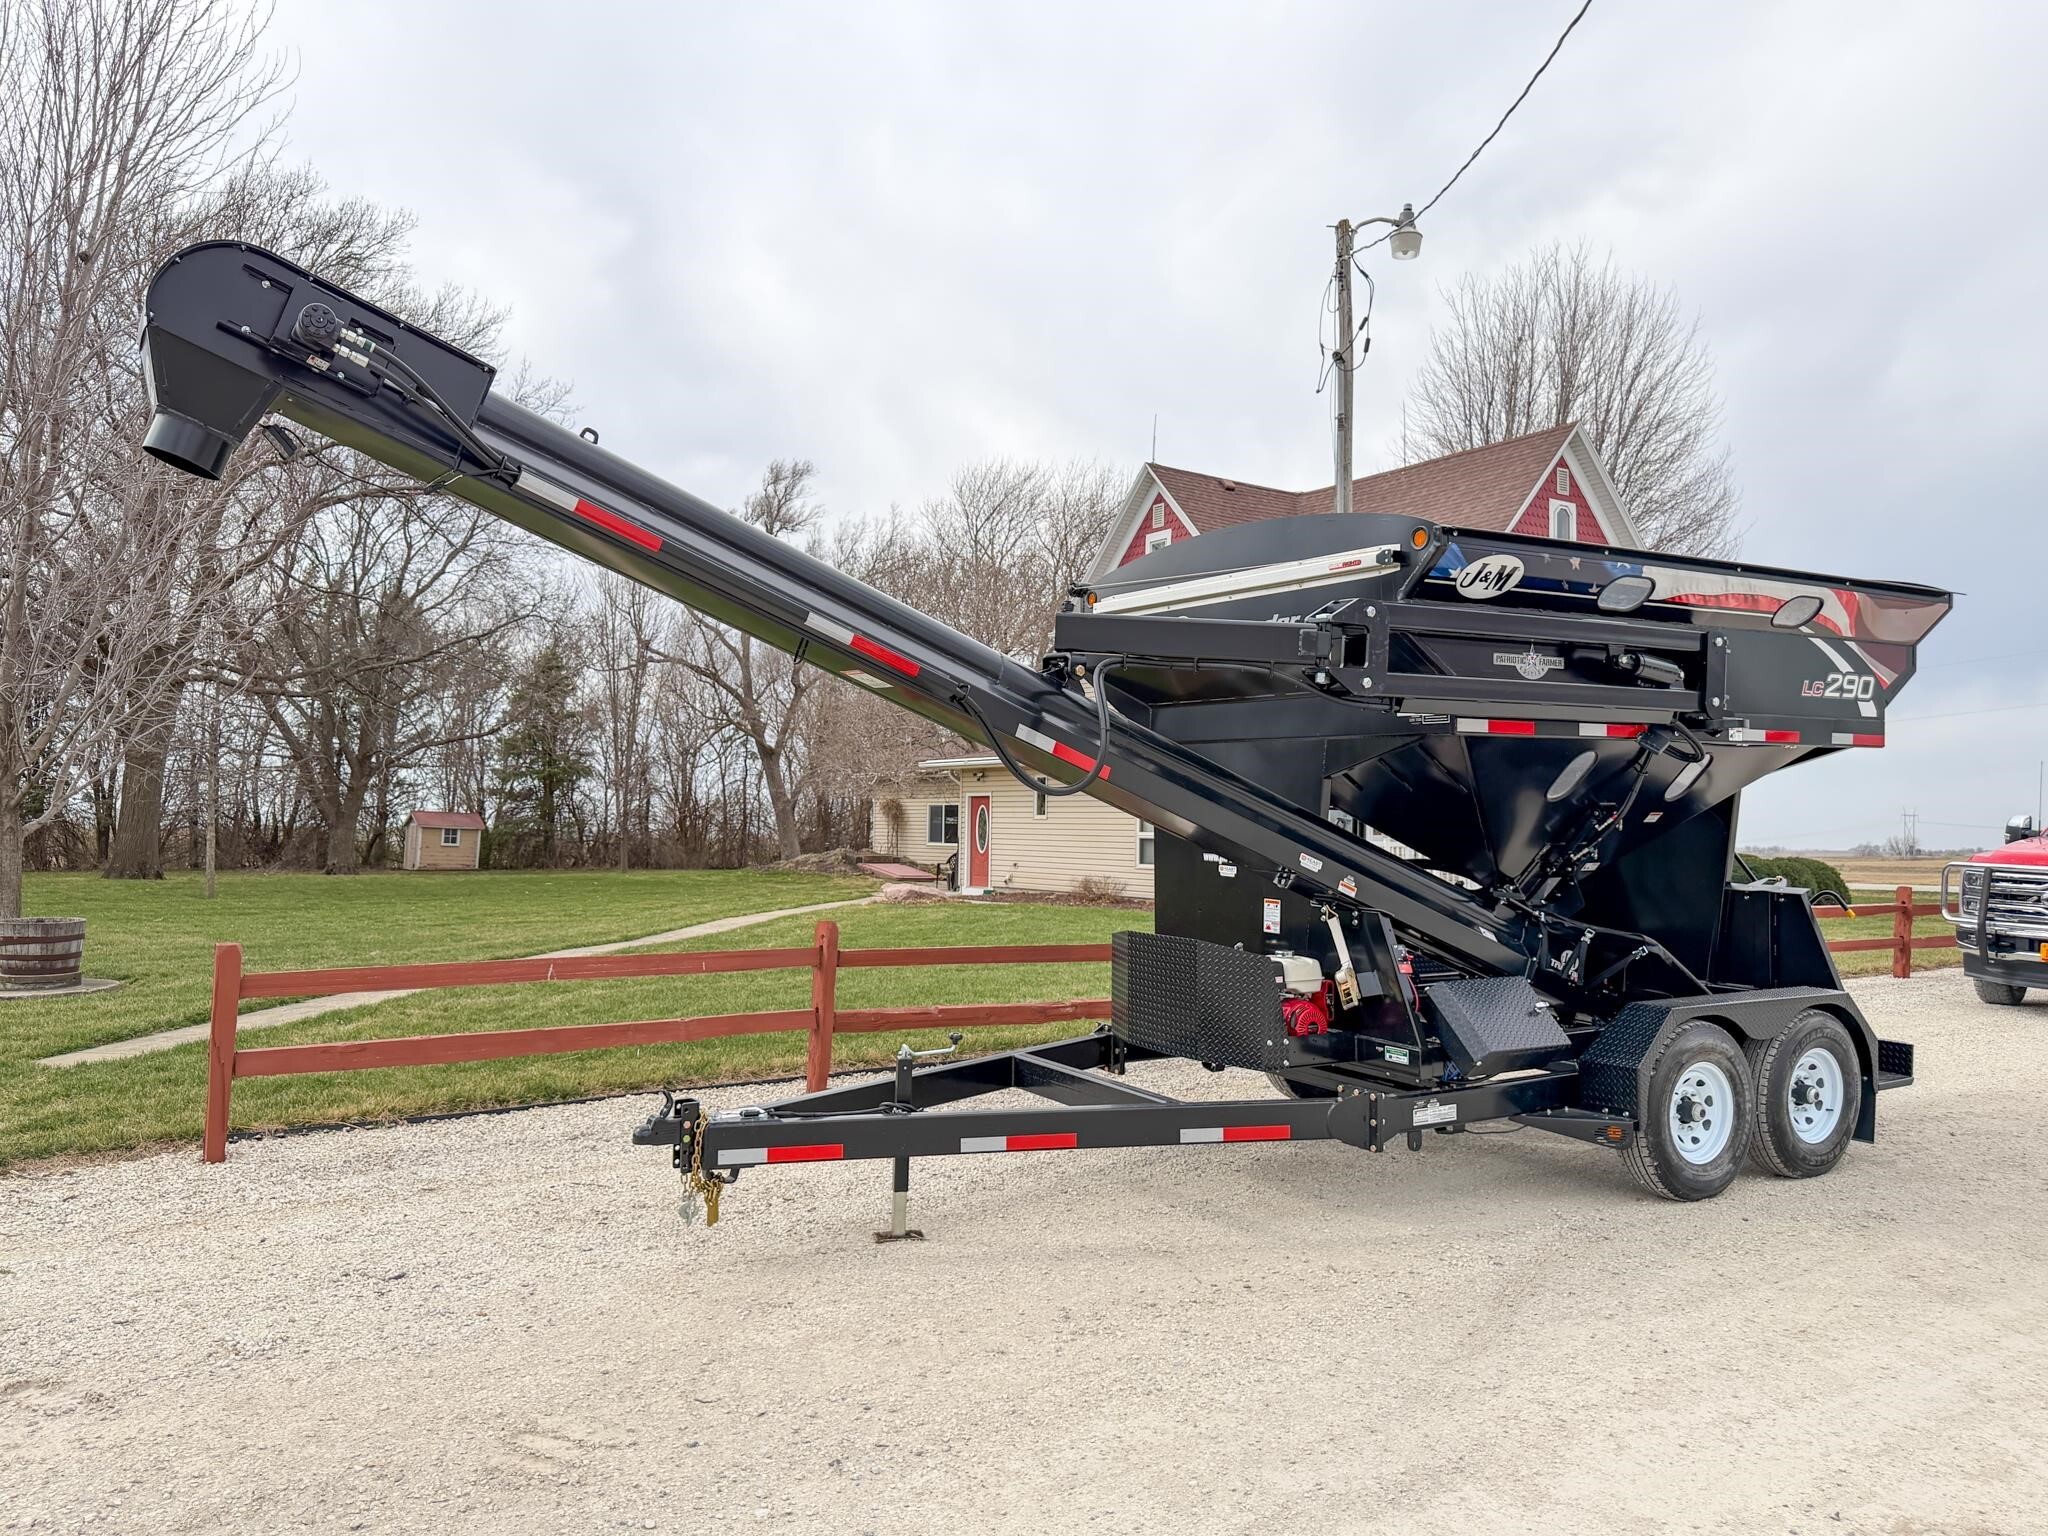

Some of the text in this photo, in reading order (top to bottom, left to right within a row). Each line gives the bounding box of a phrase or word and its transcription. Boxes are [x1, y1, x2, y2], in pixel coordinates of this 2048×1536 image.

[1459, 562, 1521, 592] J&M
[1495, 654, 1563, 667] PATRIOTIC FARMER
